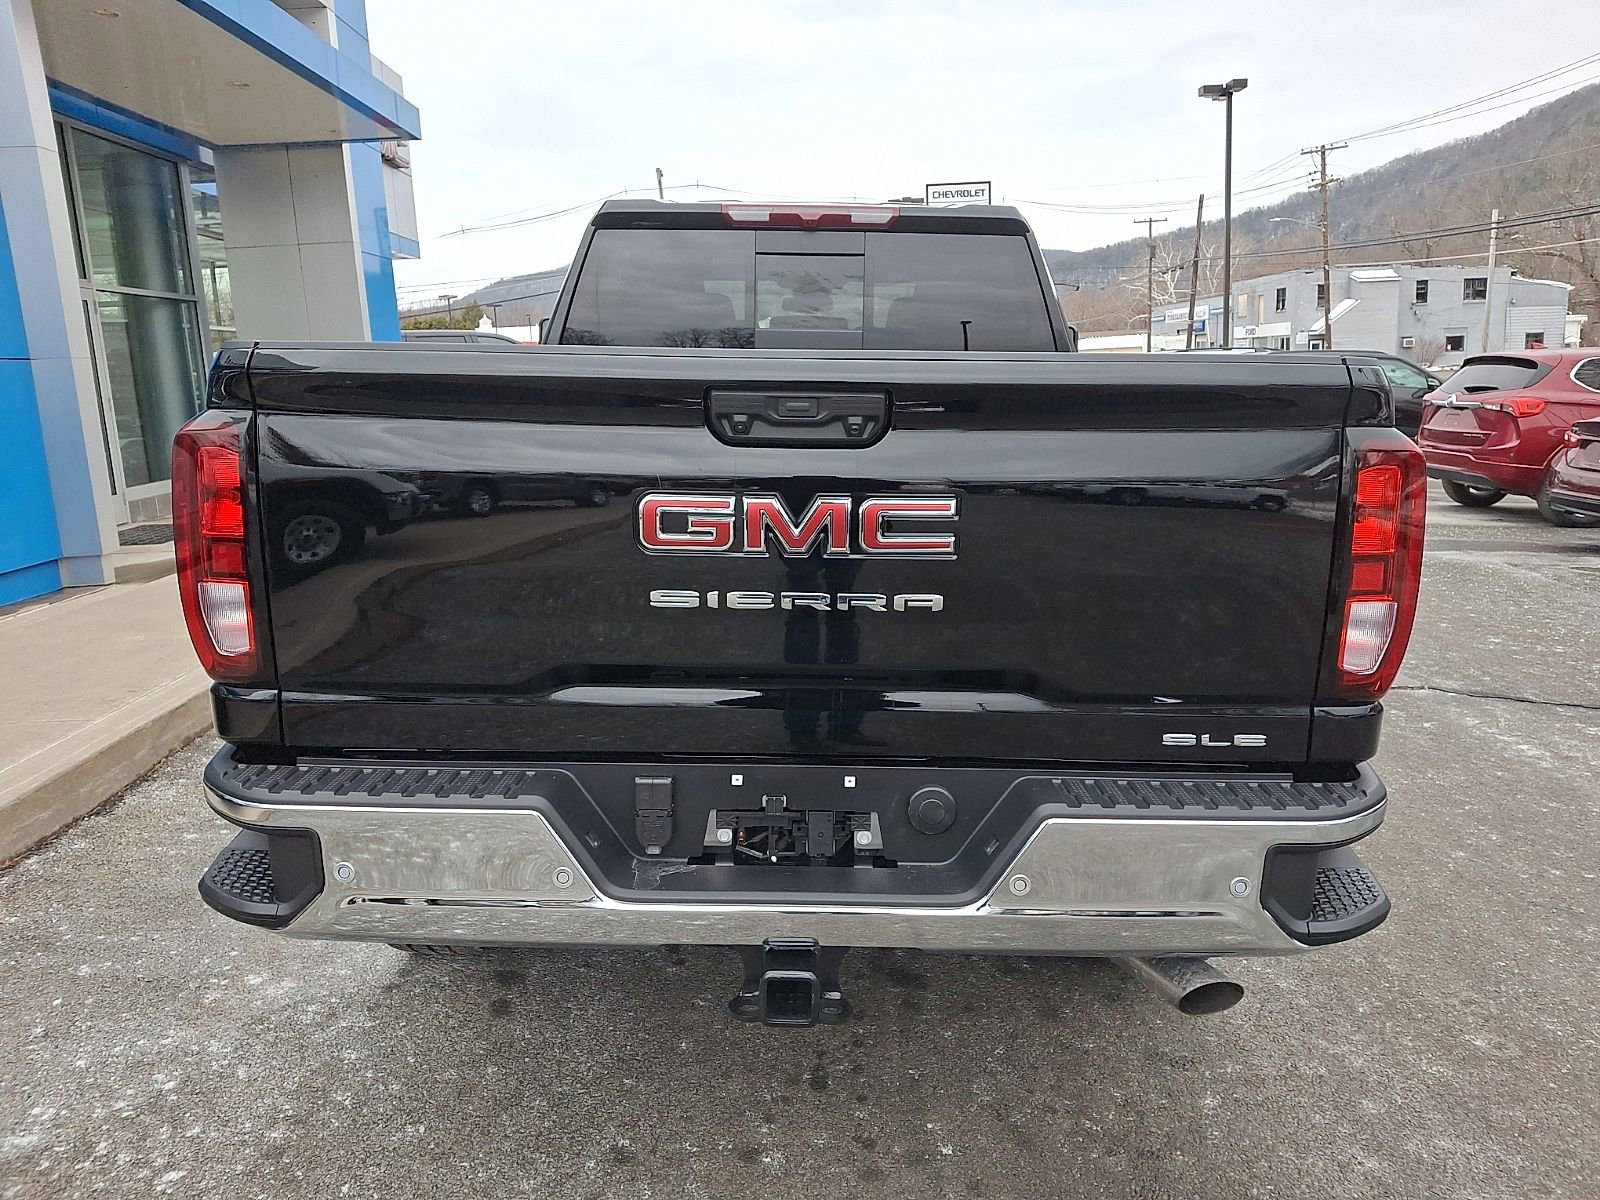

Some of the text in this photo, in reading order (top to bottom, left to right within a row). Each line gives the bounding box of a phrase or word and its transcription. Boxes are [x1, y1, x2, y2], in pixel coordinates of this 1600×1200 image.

[932, 188, 986, 199] CHEVROLET
[635, 493, 959, 559] GMC
[649, 589, 944, 612] SIERRA
[1161, 733, 1268, 747] SLE
